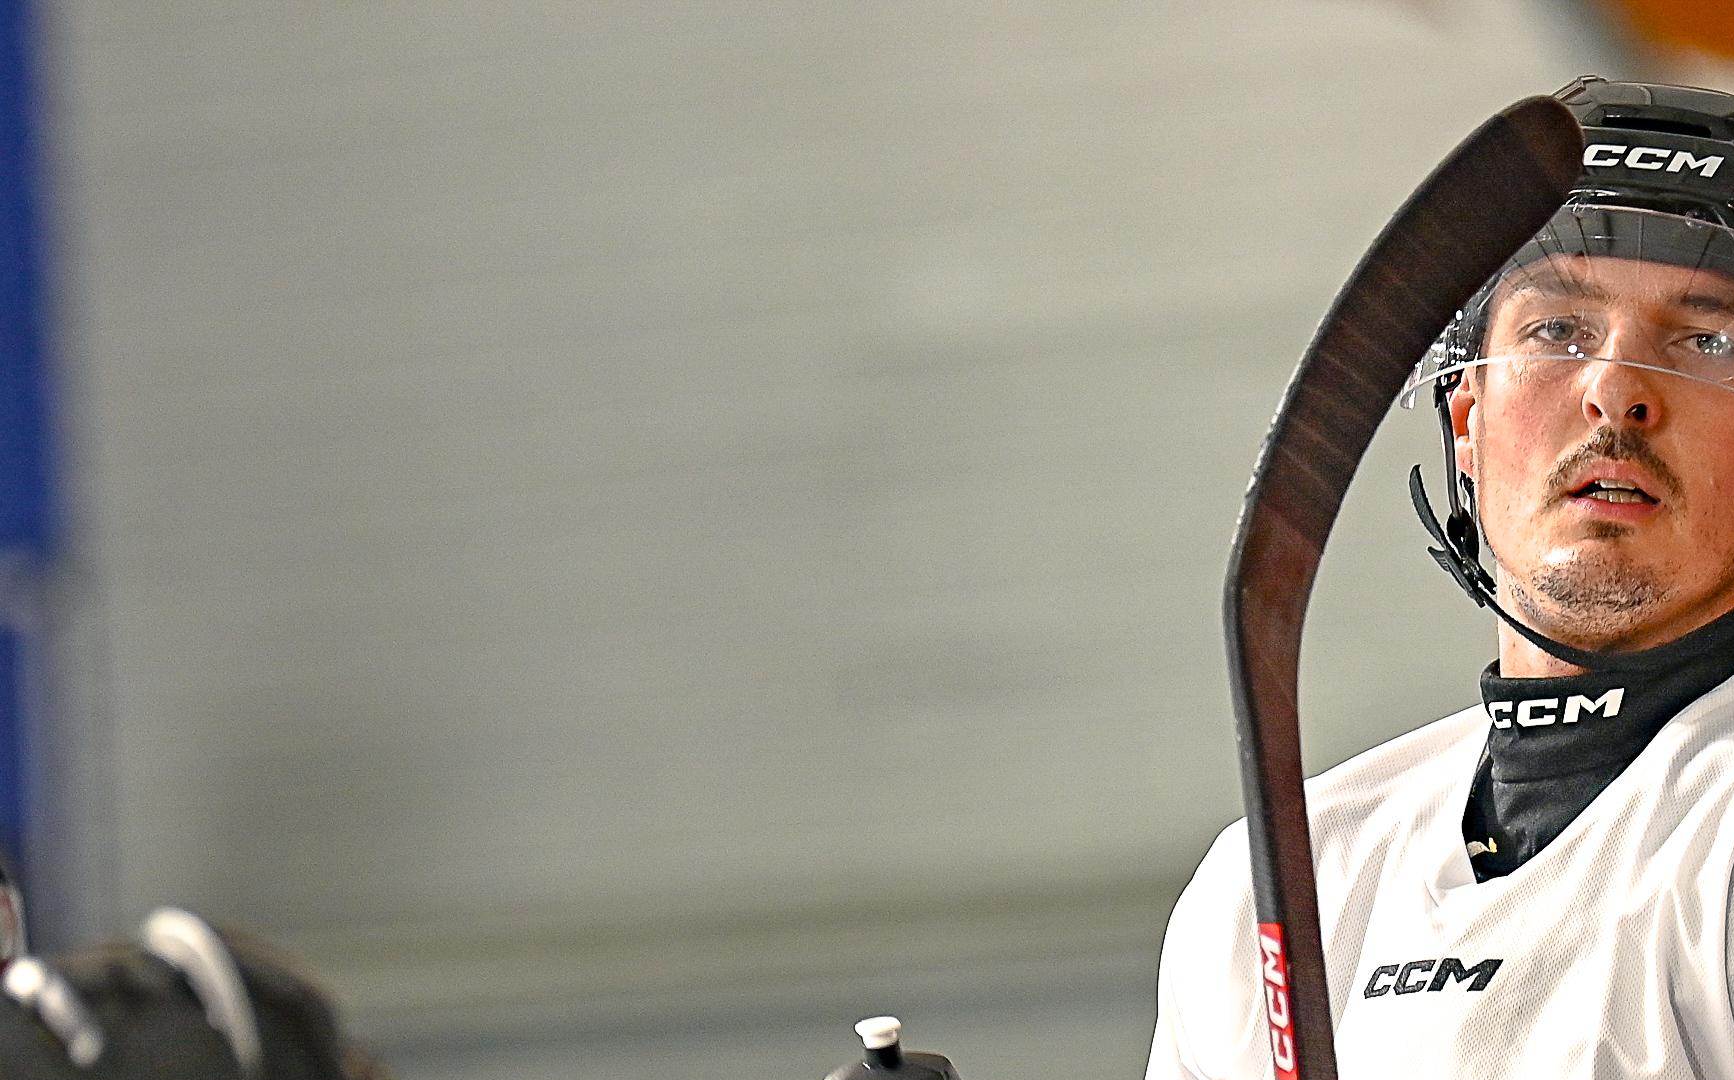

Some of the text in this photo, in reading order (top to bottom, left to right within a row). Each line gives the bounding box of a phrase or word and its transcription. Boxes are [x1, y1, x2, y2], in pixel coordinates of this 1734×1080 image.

[1583, 144, 1725, 178] CCM
[1488, 687, 1626, 730] CCM
[1363, 957, 1504, 999] CCM
[1259, 933, 1294, 1073] CCM
